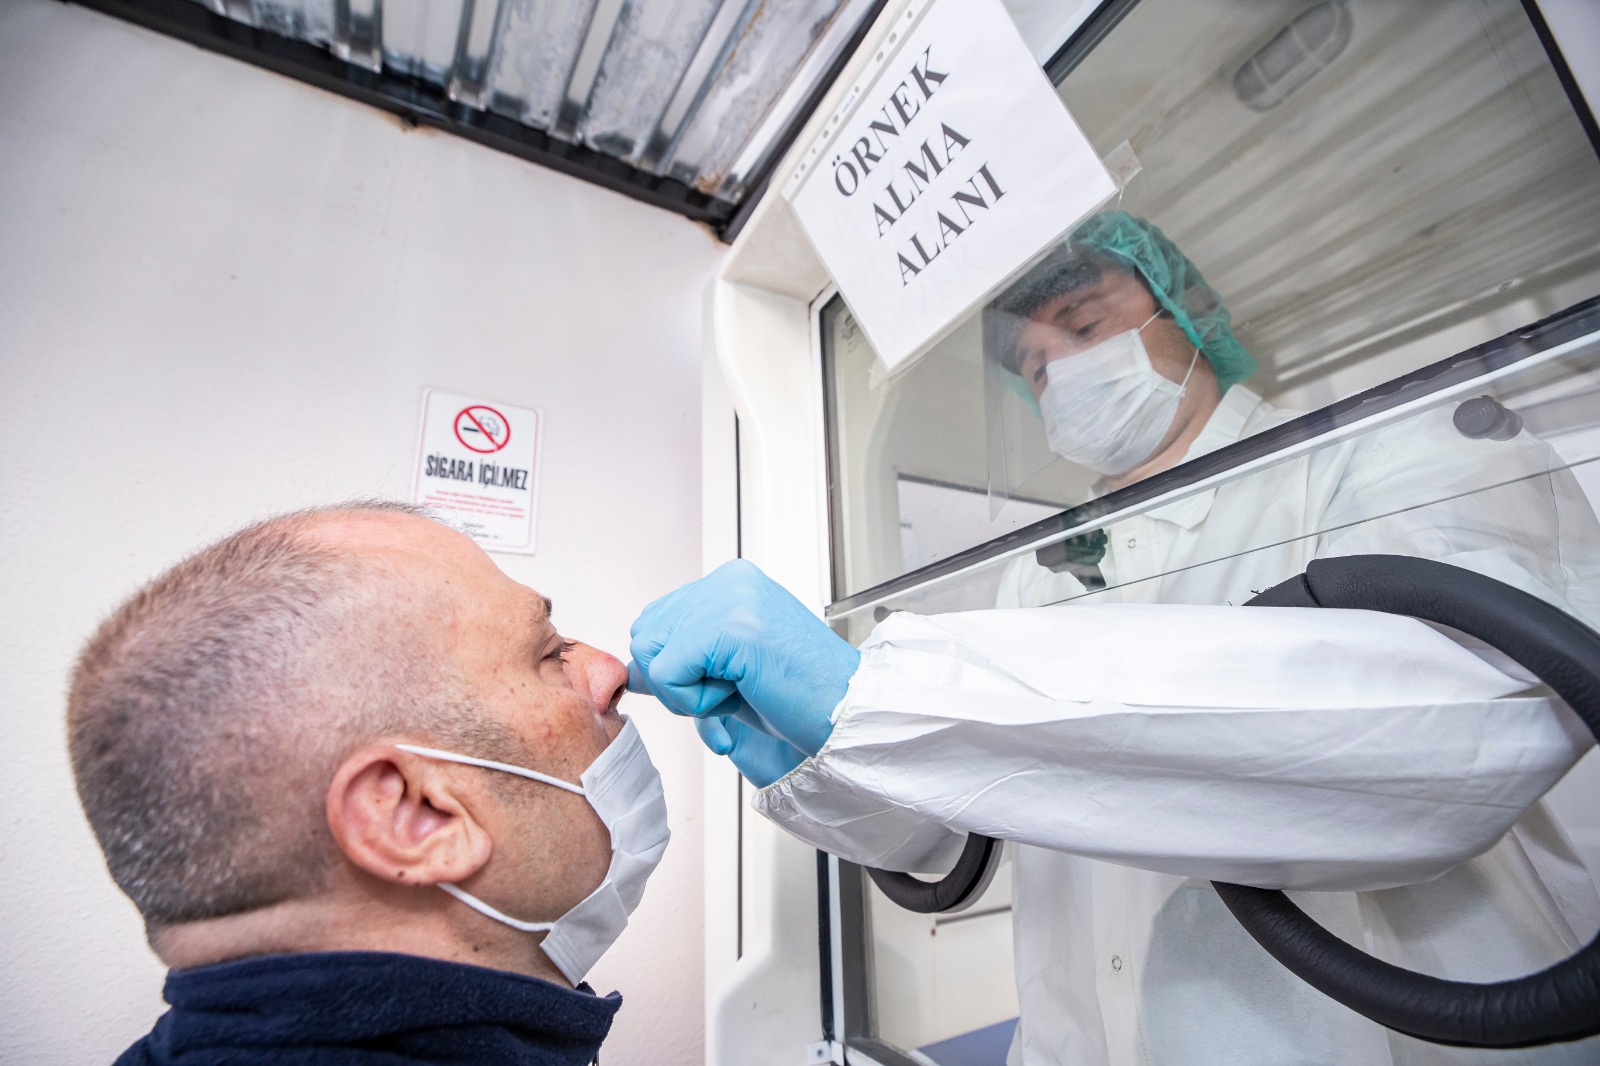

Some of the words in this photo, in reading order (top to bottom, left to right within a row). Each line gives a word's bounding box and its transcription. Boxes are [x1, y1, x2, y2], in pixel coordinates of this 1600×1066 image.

[832, 44, 950, 198] ÖRNEK
[872, 121, 972, 239] ALMA
[896, 160, 1008, 287] ALANI
[425, 451, 474, 483] SİGARA
[478, 459, 529, 491] İÇİLMEZ
